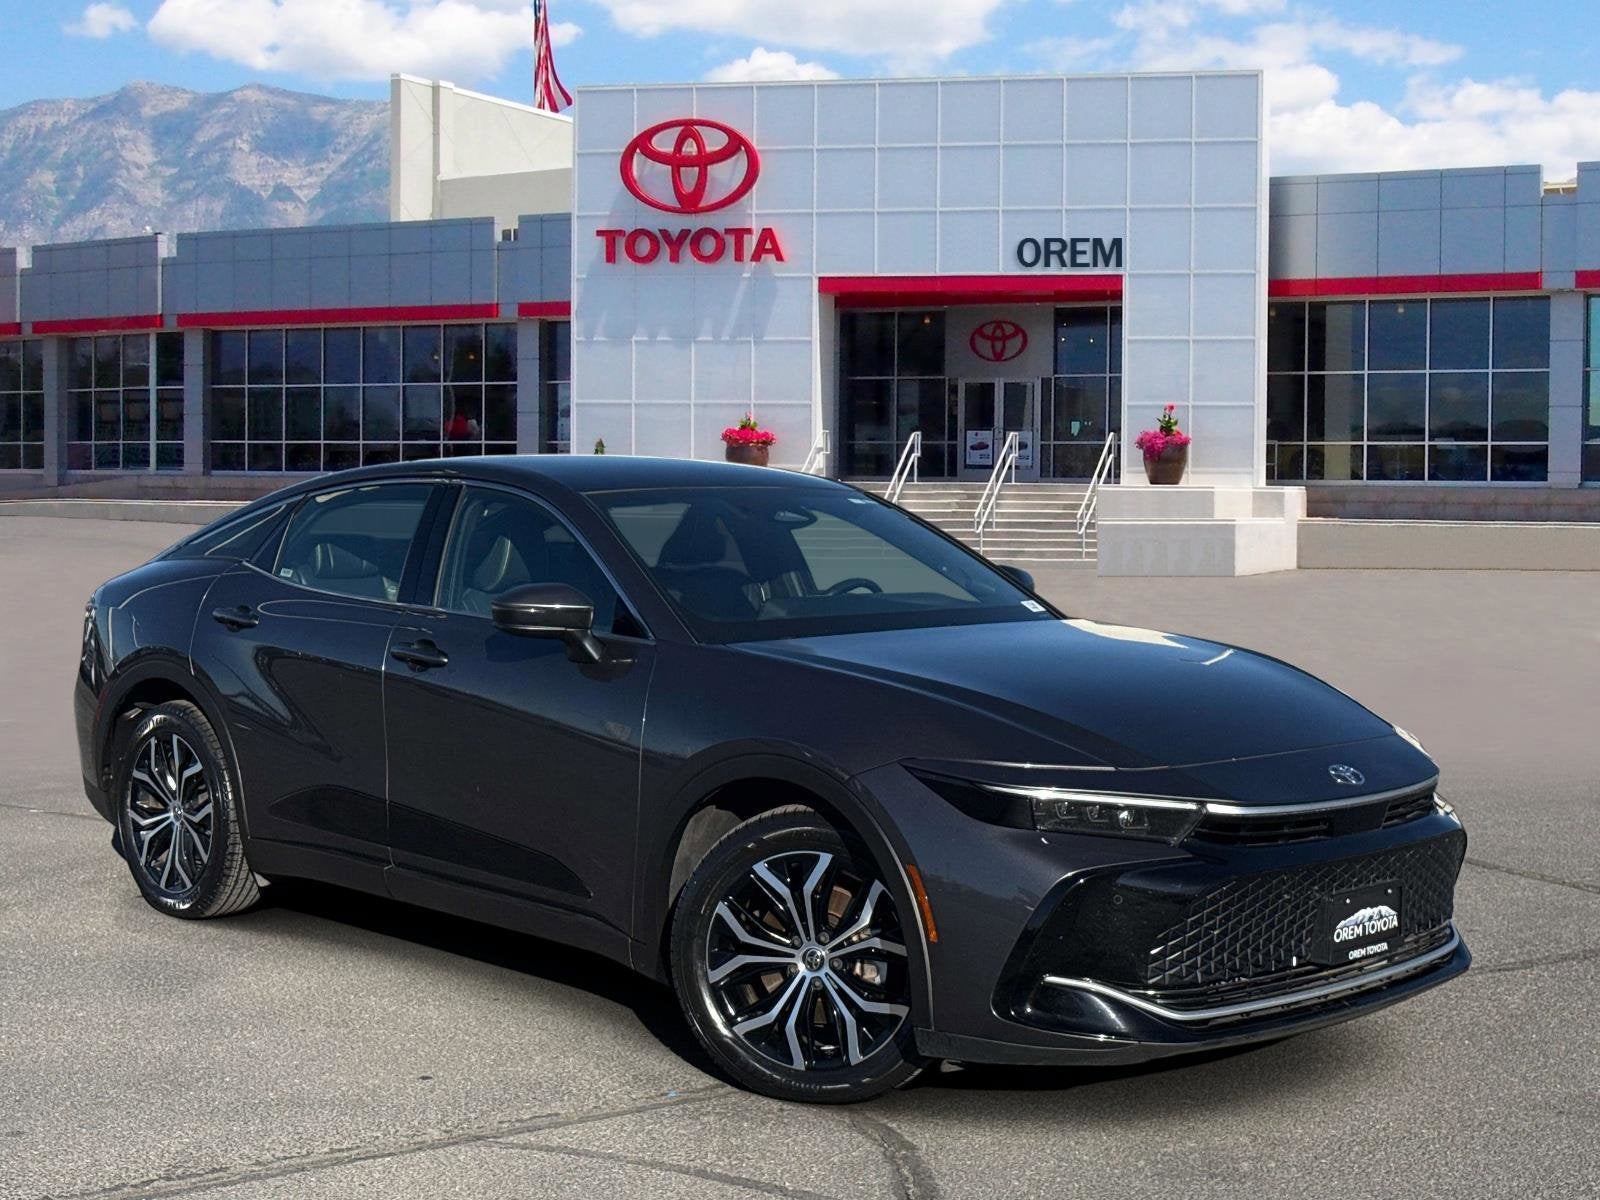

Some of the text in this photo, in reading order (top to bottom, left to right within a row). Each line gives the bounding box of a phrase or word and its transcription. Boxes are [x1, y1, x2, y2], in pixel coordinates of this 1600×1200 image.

[595, 227, 785, 265] TOYOTA
[1016, 237, 1123, 268] OREM
[1333, 914, 1399, 943] OREM TOYOTA
[1348, 942, 1388, 960] OREM TOYOTA
